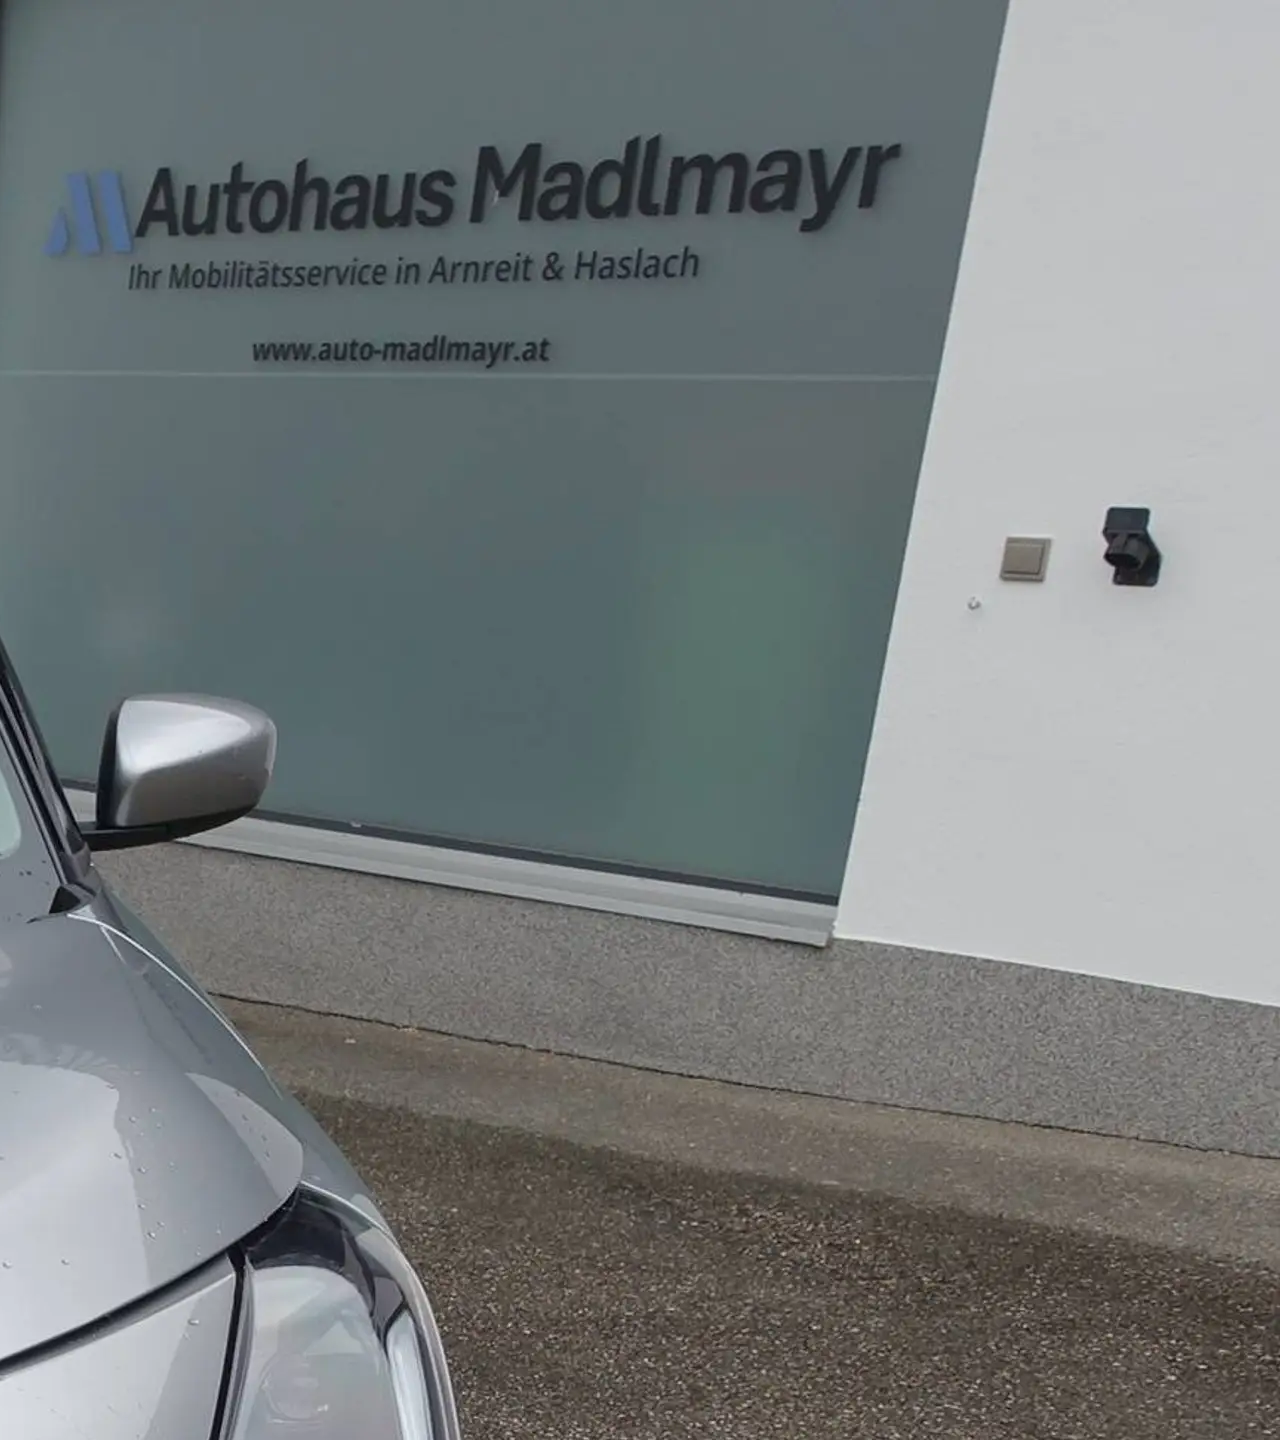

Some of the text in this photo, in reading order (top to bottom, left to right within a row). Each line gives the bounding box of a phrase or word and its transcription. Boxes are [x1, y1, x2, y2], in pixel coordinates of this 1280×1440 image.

[134, 133, 901, 238] Autohaus Madlmayr
[128, 246, 700, 290] Ihr Mobilitätsservice in Arnreit & Haslach
[251, 335, 551, 368] www.auto-madlmayr.at
